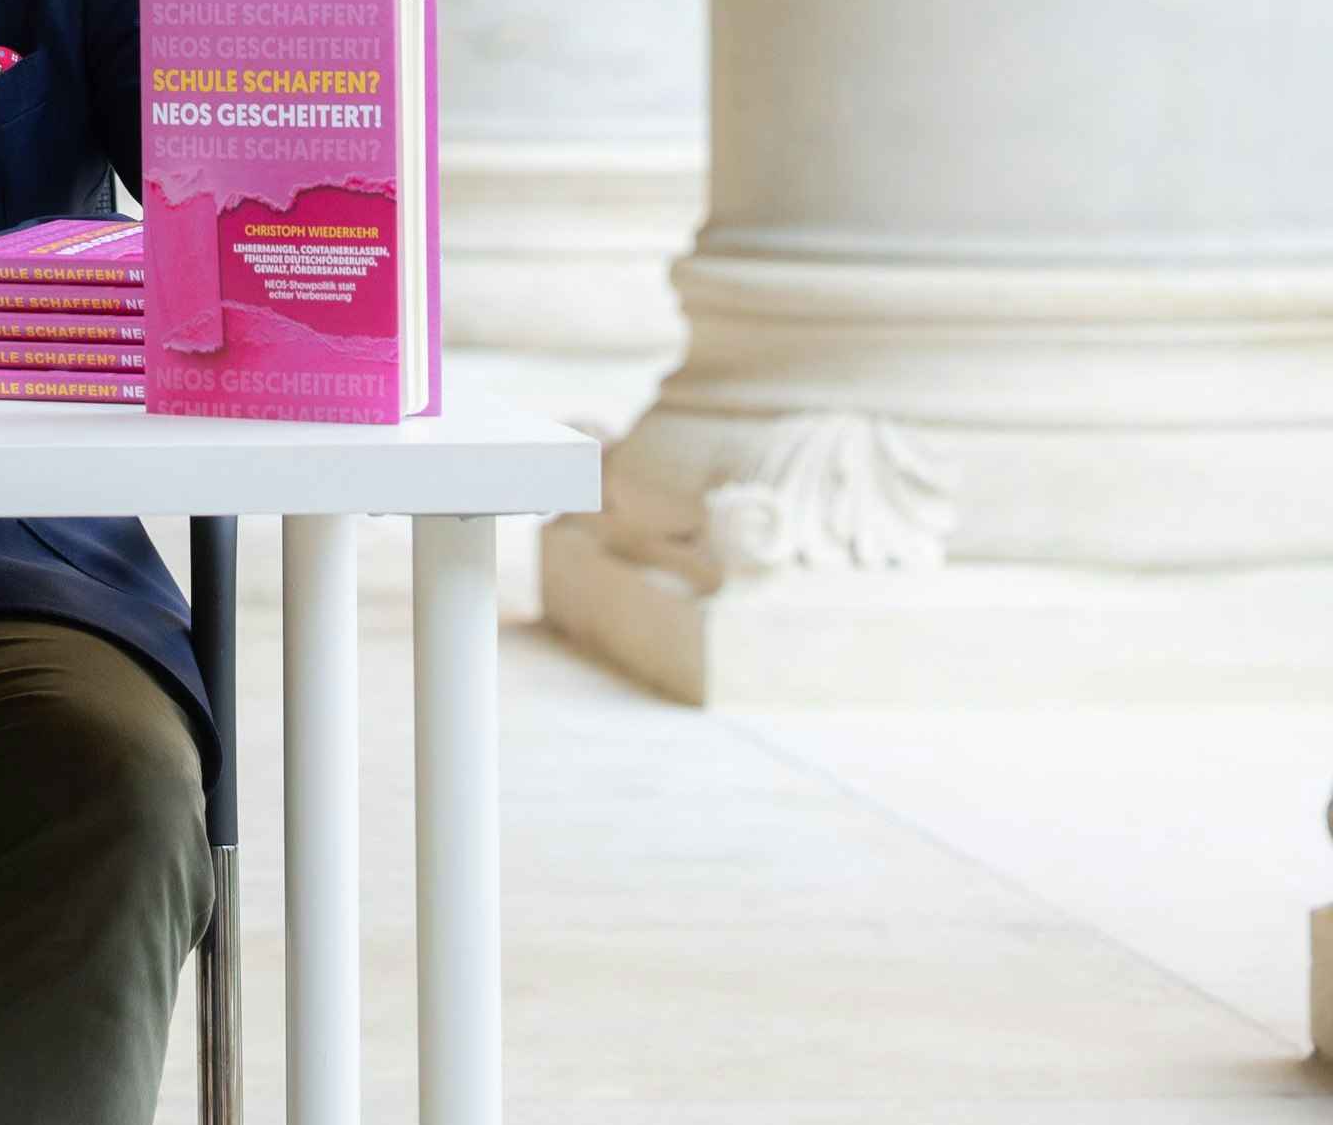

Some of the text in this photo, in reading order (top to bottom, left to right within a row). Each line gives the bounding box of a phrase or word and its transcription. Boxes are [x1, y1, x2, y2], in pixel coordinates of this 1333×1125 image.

[152, 3, 379, 26] SCHULE SCHAFFEN?
[152, 36, 380, 60] NEOS GESCHEITERT!
[153, 69, 380, 94] SCHULE SCHAFFEN?
[152, 103, 382, 128] NEOS GESCHEITERT!
[154, 136, 381, 161] SCHULE SCHAFFEN?
[245, 224, 379, 239] CHRISTOPH WIEDERKEHR
[233, 243, 390, 257] LEHRERMANGEL, CONTAINERKLASSEN,
[244, 254, 378, 267] FEHLENDE DEUTSCHFÖRDERUNG,
[34, 268, 124, 281] SCHAFFEN?
[254, 264, 367, 276] GEWALT, FÖRDERSKANDALE
[264, 279, 356, 292] NEOS-Showpolitik statt
[29, 296, 121, 310] SCHAFFEN?
[126, 299, 144, 310] NE
[269, 290, 352, 303] echter Verbesserung
[26, 326, 116, 339] SCHAFFEN?
[121, 328, 145, 340] NE
[24, 352, 116, 366] SCHAFFEN?
[121, 355, 145, 367] NE
[155, 368, 383, 397] NEOS GESCHEITERT!
[25, 383, 118, 397] SCHAFFEN?
[122, 386, 144, 398] NE
